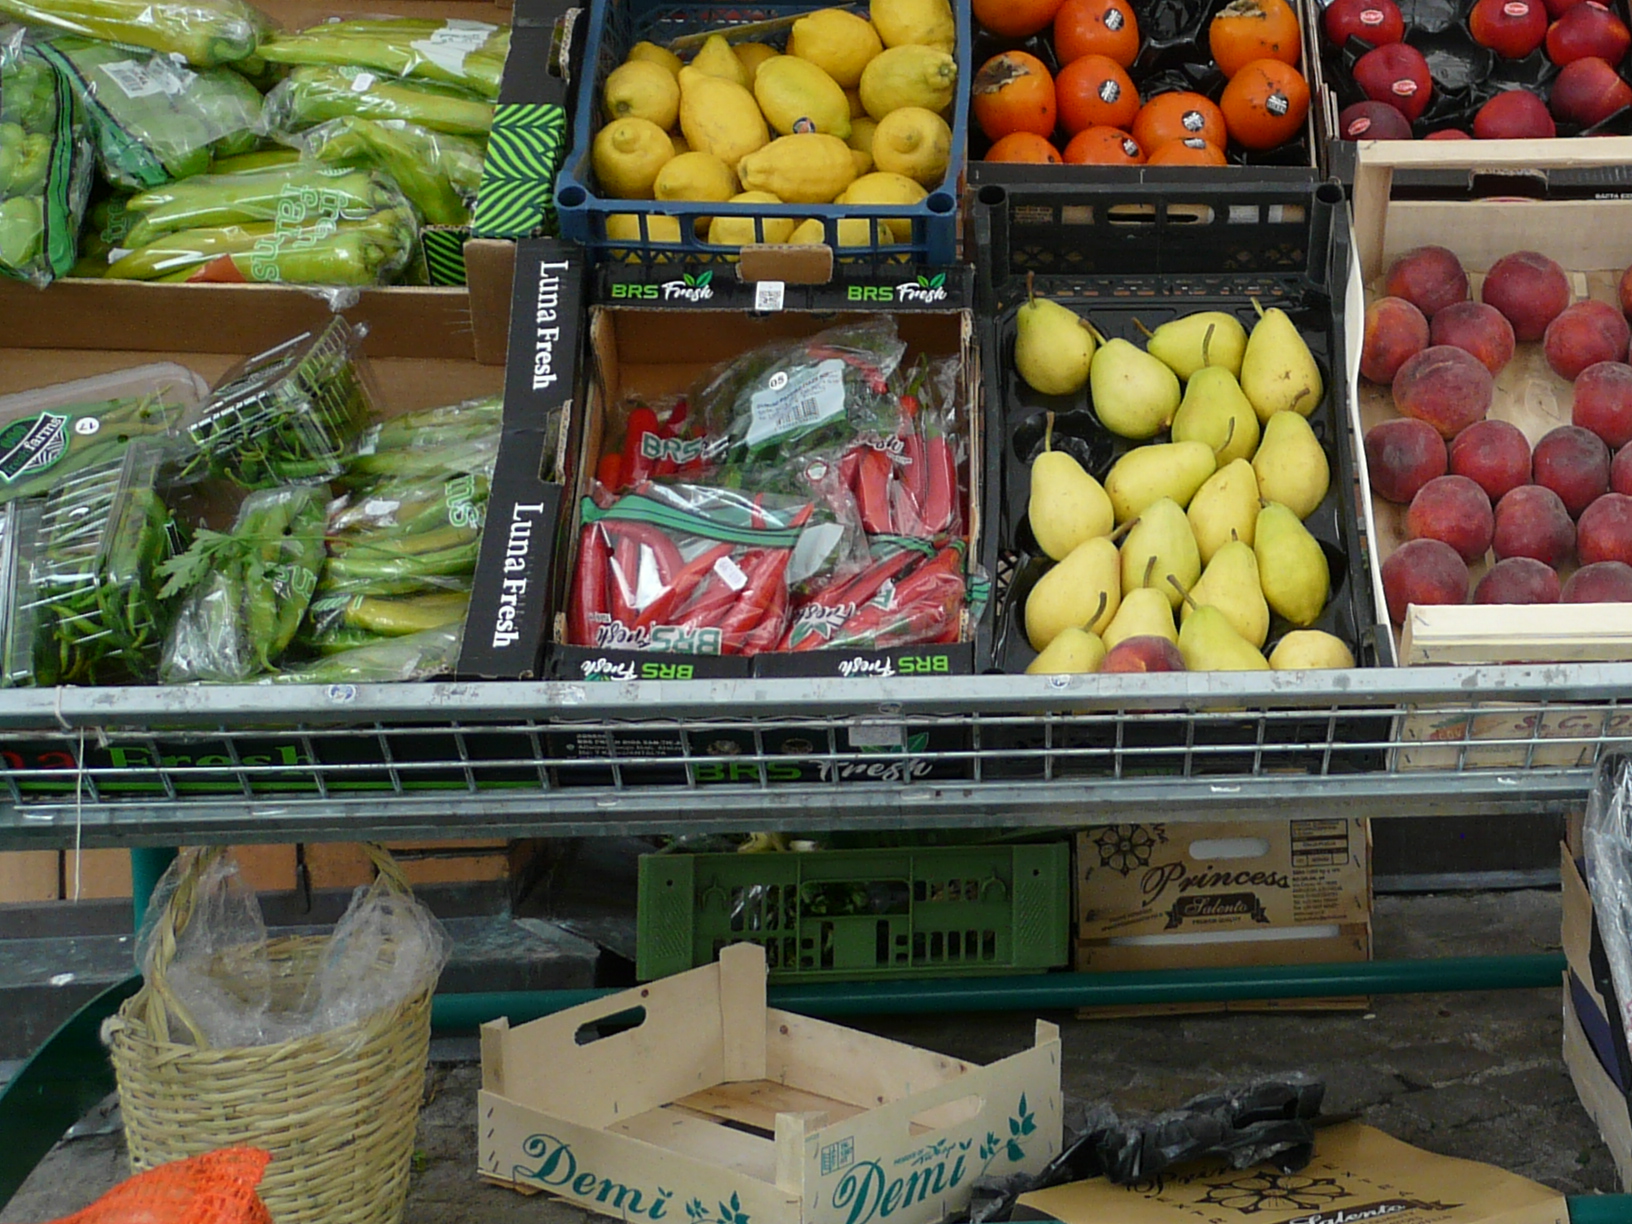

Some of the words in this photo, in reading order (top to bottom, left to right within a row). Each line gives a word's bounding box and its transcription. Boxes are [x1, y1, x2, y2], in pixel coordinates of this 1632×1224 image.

[536, 260, 569, 323] Luna
[611, 283, 659, 300] BRS
[661, 280, 714, 302] Fresh
[847, 285, 894, 302] BRS
[896, 282, 948, 304] Fresh
[532, 326, 560, 390] Fresh
[641, 431, 702, 464] BRS
[503, 502, 544, 574] Luna
[492, 577, 528, 649] Fresh
[600, 622, 653, 650] Fresh
[651, 626, 723, 655] BRS
[581, 657, 638, 681] Fresh
[642, 662, 694, 680] BRS
[838, 656, 897, 677] Fresh
[898, 654, 949, 673] BRS
[106, 744, 321, 776] Fresh
[689, 760, 802, 781] BRS
[808, 757, 934, 781] Fresh
[1141, 861, 1291, 908] Princess
[1184, 896, 1249, 916] Salento
[512, 1133, 673, 1220] Demi
[832, 1138, 973, 1224] Demi
